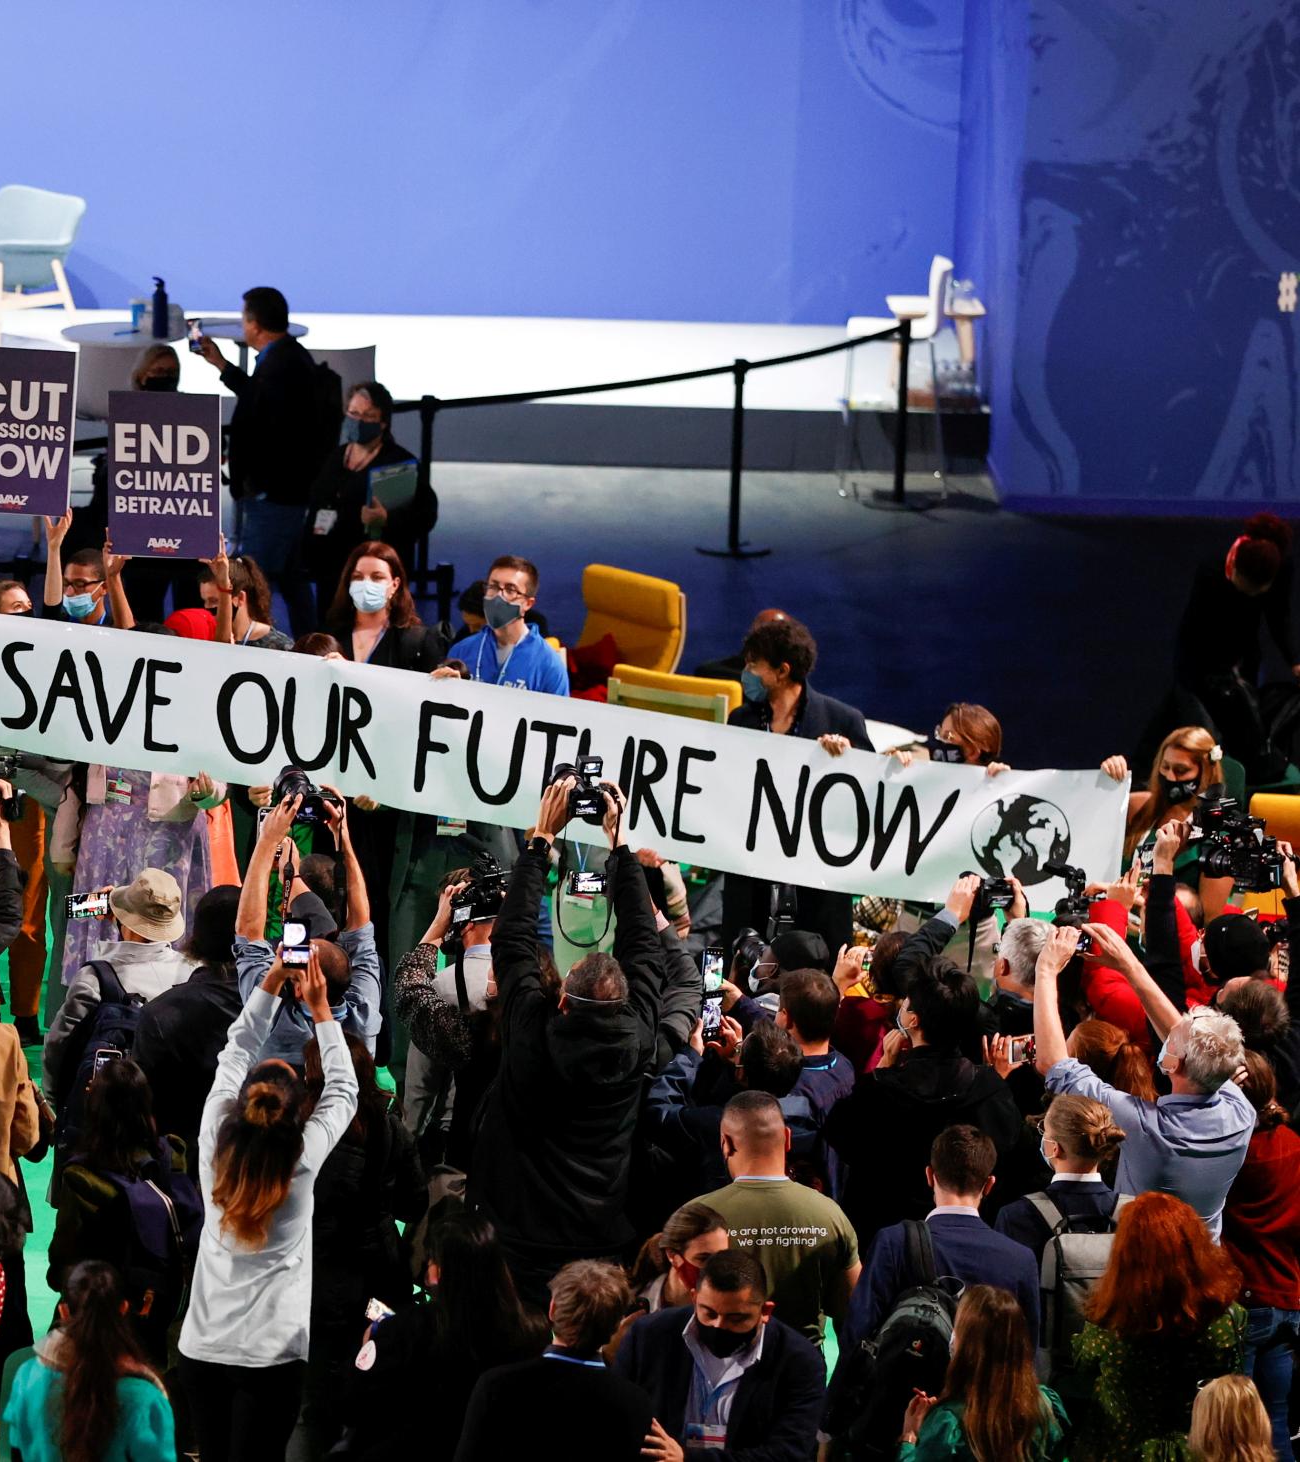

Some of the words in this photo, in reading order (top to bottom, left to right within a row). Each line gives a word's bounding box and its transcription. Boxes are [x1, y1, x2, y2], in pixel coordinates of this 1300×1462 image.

[114, 423, 210, 465] END
[115, 470, 213, 493] CLIMATE
[115, 496, 213, 517] BETRAYAL
[147, 537, 182, 550] AVAAZ
[1, 642, 183, 753] SAVE
[217, 672, 377, 780] OUR
[746, 759, 962, 875] NOW
[737, 1238, 753, 1247] We
[756, 1238, 773, 1246] are
[775, 1236, 817, 1247] fighting!
[740, 1228, 758, 1236] are
[761, 1227, 777, 1235] not
